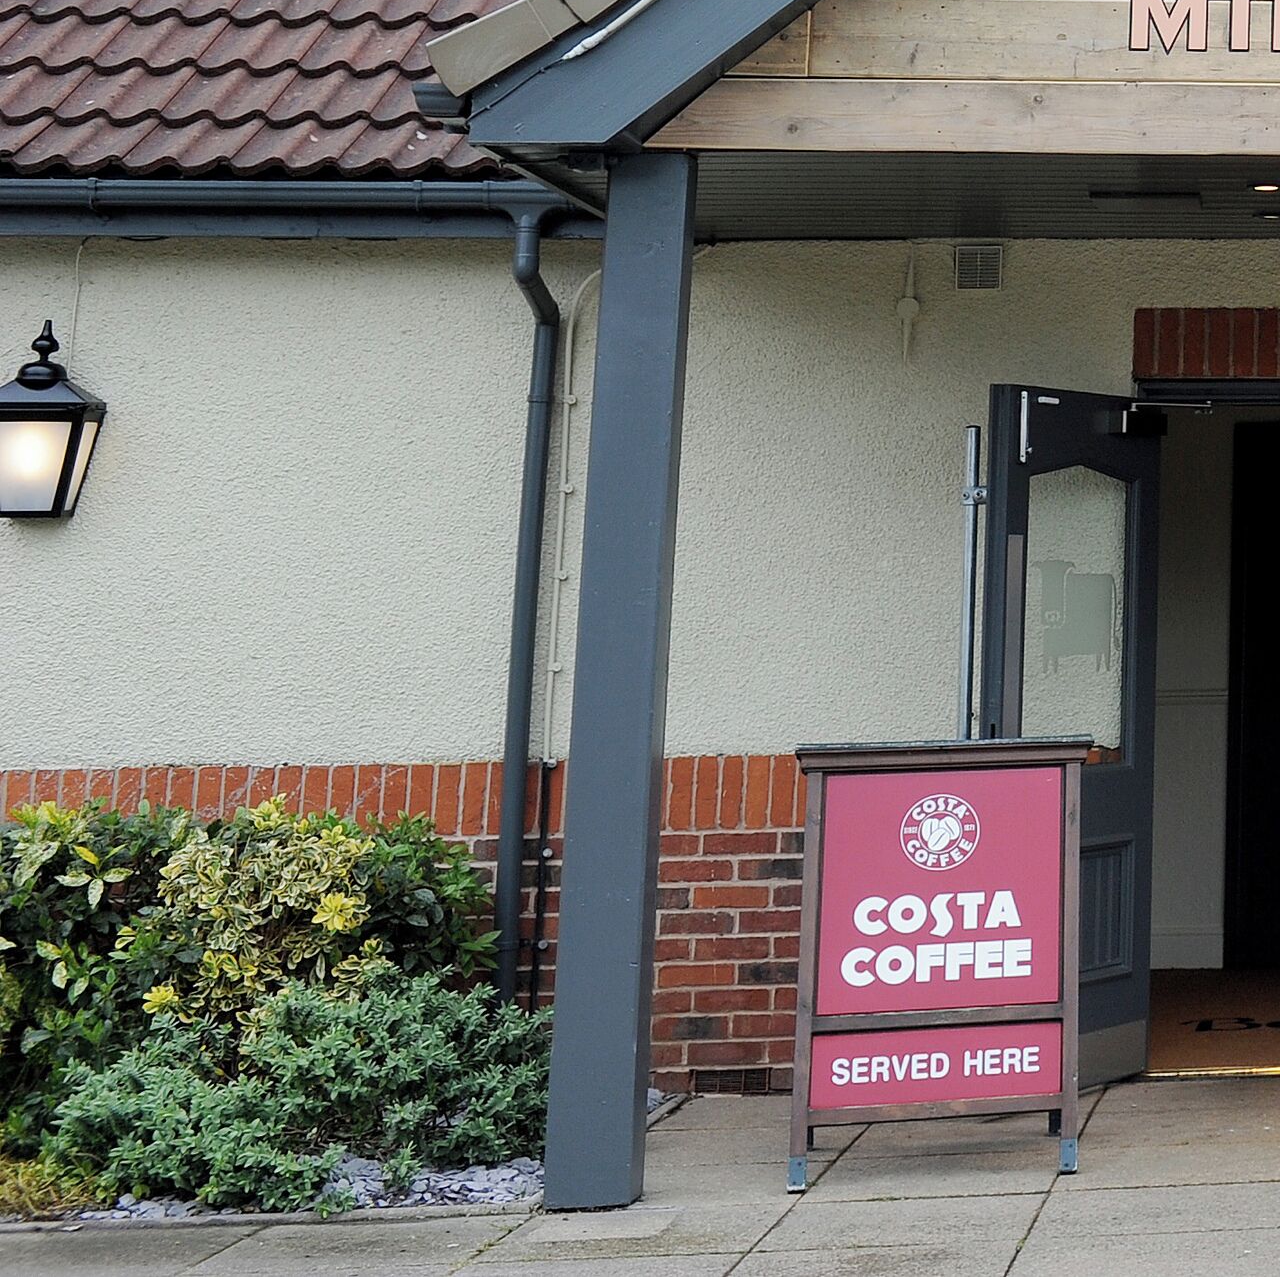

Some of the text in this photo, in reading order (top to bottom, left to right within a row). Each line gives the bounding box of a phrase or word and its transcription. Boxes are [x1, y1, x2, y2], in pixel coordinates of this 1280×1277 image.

[912, 797, 970, 821] COSTA
[907, 838, 974, 867] COFFEE
[853, 890, 1022, 937] COSTA
[840, 938, 1033, 988] COFFEE
[831, 1046, 1041, 1087] SERVED HERE
